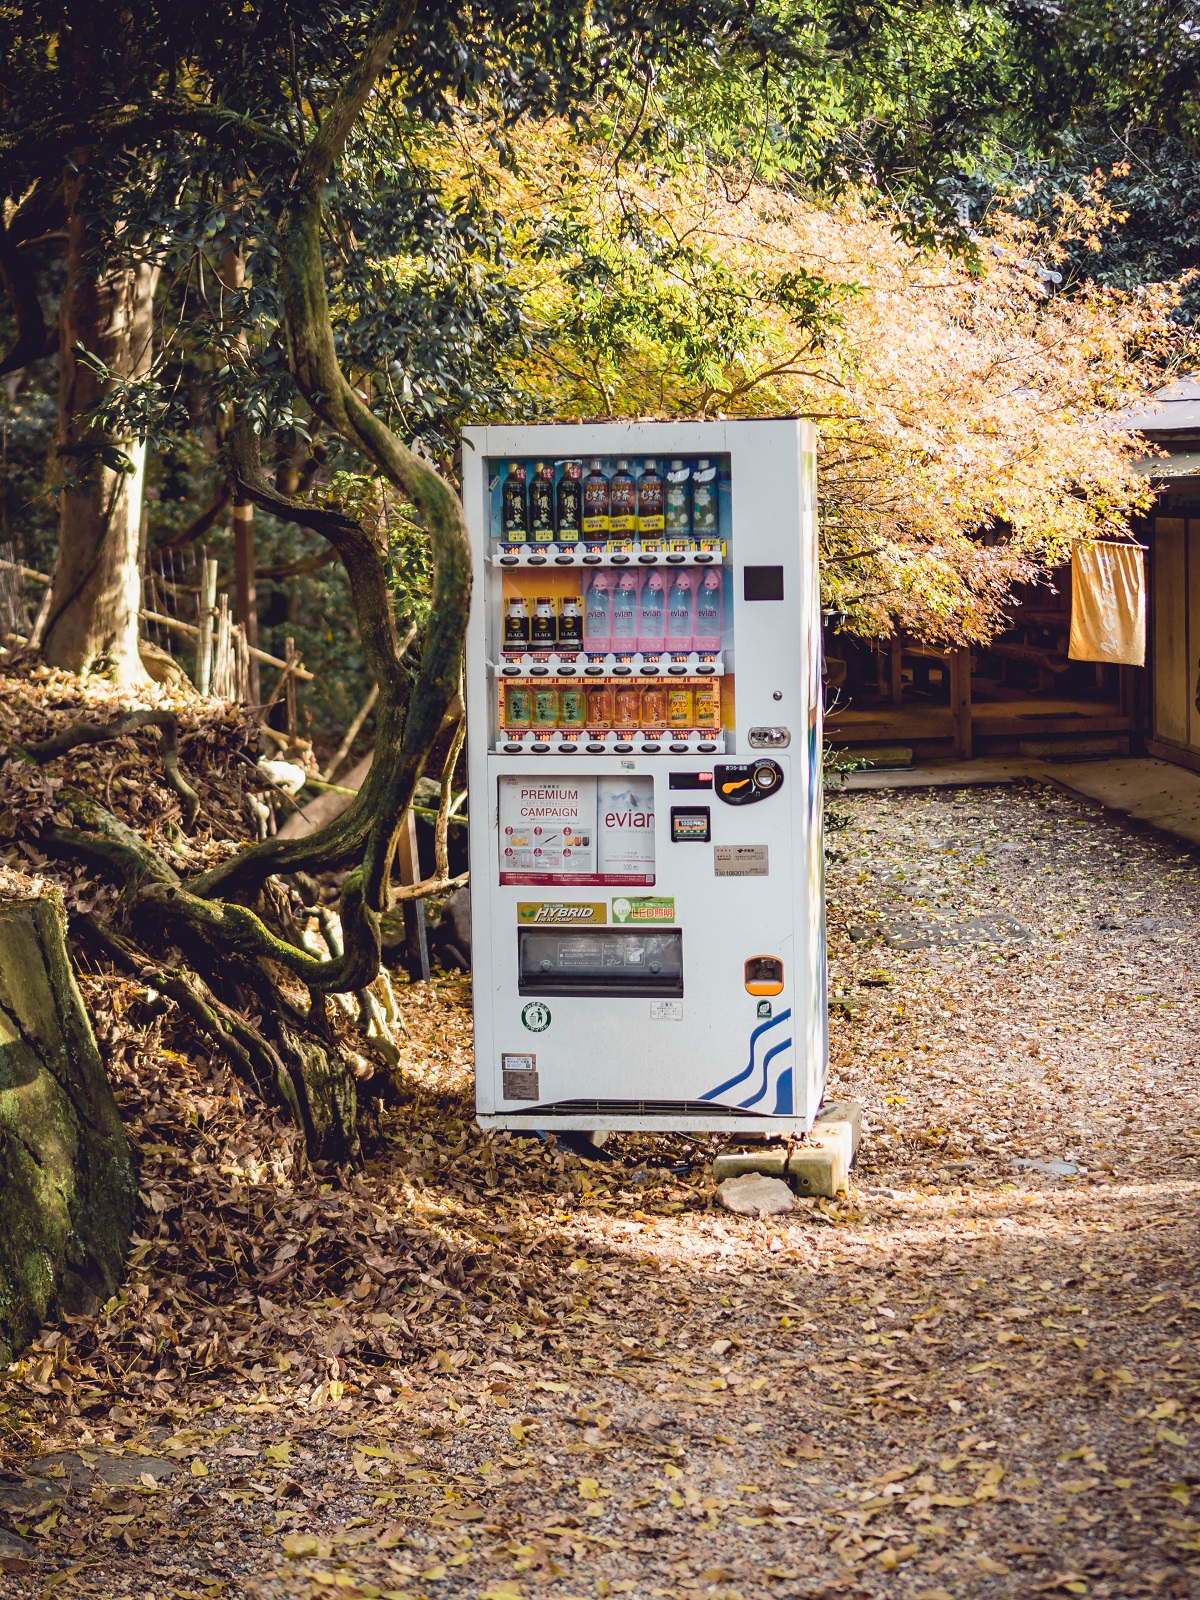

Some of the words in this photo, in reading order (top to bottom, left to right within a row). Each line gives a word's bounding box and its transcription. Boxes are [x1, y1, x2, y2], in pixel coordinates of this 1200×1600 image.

[587, 610, 606, 618] evian
[614, 610, 633, 618] evian
[698, 609, 717, 617] evian
[521, 790, 578, 800] PREMIUM
[520, 807, 578, 817] CAMPAIGN
[534, 907, 594, 922] HYBRID
[631, 907, 674, 919] LED照明
